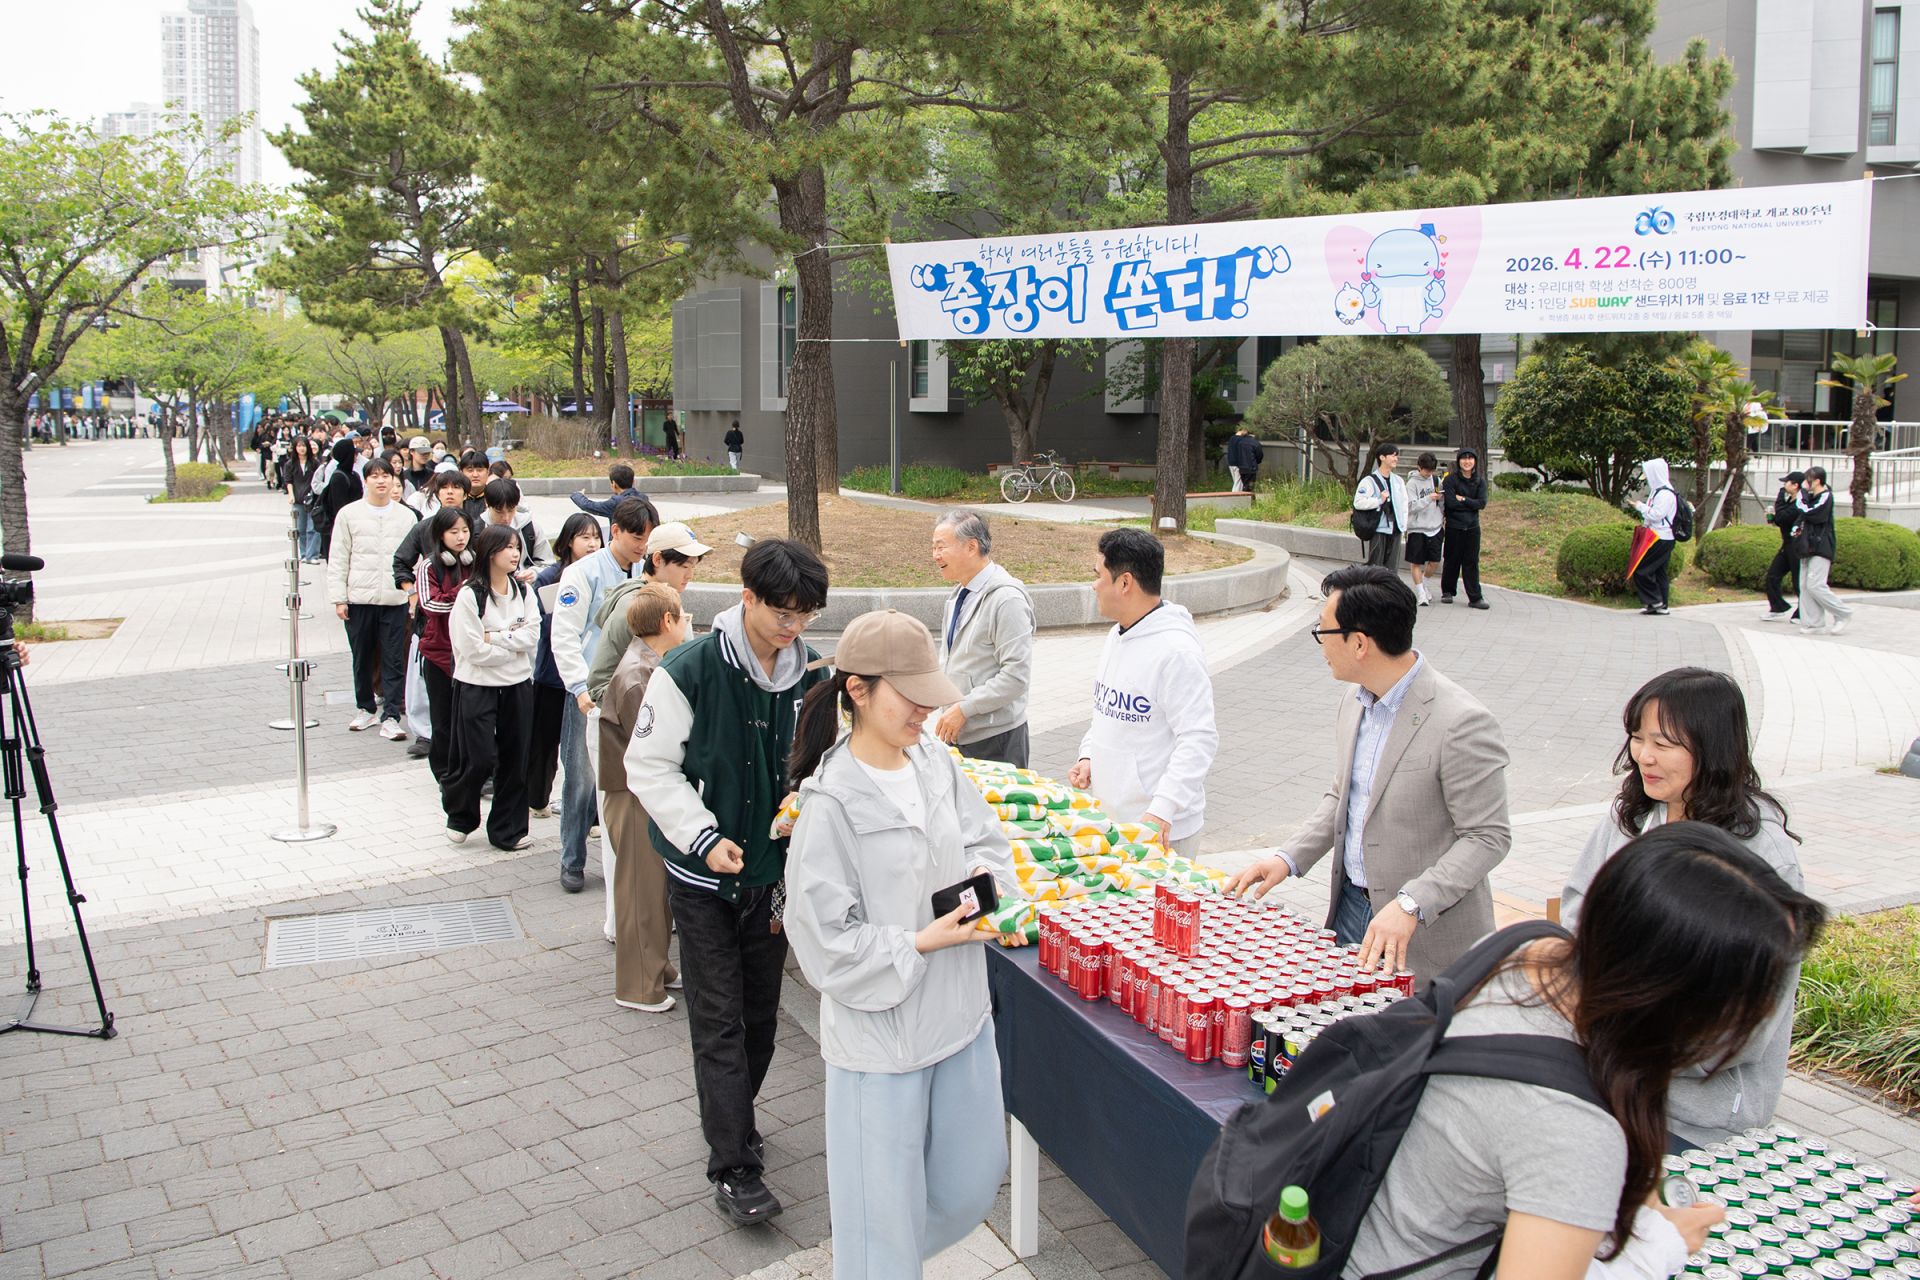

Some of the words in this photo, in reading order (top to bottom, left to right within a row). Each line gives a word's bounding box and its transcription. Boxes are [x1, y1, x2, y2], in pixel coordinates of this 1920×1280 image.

[1685, 208, 1762, 223] 국립부경대학교
[1766, 207, 1789, 218] 개교
[1792, 204, 1833, 217] 80주년
[1691, 224, 1729, 232] PUKYONG
[1732, 222, 1773, 230] NATIONAL
[1776, 219, 1824, 228] UNIVERSITY
[979, 244, 1013, 269] 학생
[1021, 238, 1095, 266] 여러분들을
[1101, 232, 1199, 260] 응원합니다!
[1505, 257, 1558, 272] 2026.
[1678, 248, 1747, 266] 11:00~
[1538, 280, 1585, 294] 우리대학
[1589, 279, 1613, 293] 학생
[1617, 278, 1654, 292] 선착순
[1658, 277, 1697, 290] 800명
[1538, 297, 1567, 310] 1인당
[1569, 296, 1633, 308] SUBWAY
[1635, 293, 1683, 308] 샌드위치
[1686, 293, 1704, 306] 1개
[1707, 293, 1719, 306] 및
[1722, 291, 1748, 306] 음료
[1750, 290, 1770, 305] 1잔
[1774, 290, 1799, 304] 무료
[1802, 289, 1829, 304] 제공
